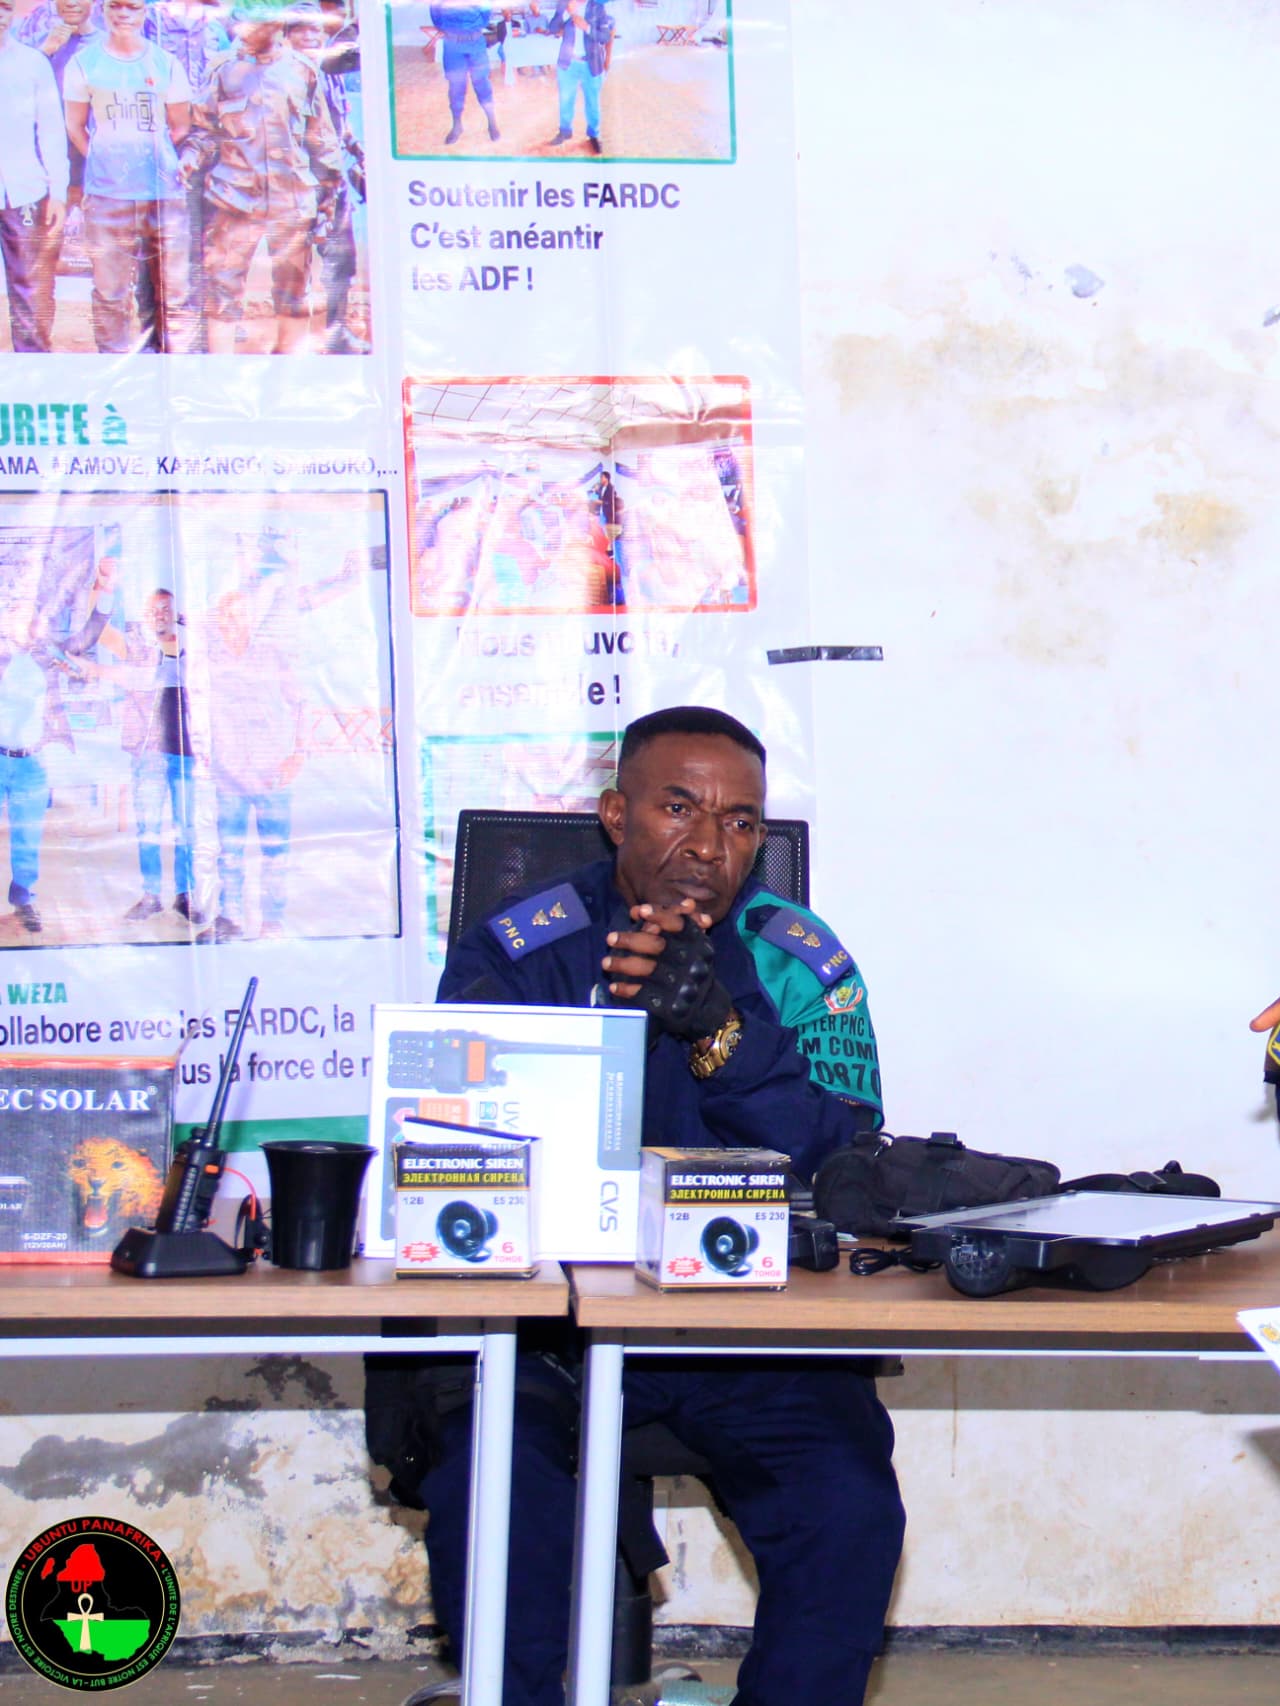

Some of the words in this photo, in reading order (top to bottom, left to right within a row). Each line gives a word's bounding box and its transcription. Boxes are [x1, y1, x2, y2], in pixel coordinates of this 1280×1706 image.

[408, 180, 529, 208] Soutenir
[535, 181, 576, 208] les
[583, 183, 681, 209] FARDC
[410, 222, 482, 249] C'est
[489, 222, 604, 250] anéantir
[412, 266, 451, 291] les
[459, 266, 519, 291] ADF
[101, 403, 129, 446] à
[498, 917, 525, 949] PNC
[821, 950, 848, 975] PNC
[7, 982, 68, 1005] WEZA
[109, 1017, 172, 1041] avec
[333, 1003, 354, 1033] la
[841, 1014, 865, 1036] PNC
[248, 1052, 315, 1082] force
[322, 1049, 354, 1079] de
[403, 1158, 483, 1169] ELECTRONIC
[485, 1158, 525, 1169] SIREN
[403, 1173, 480, 1184] ЭЛЕКТРОННАЯ
[483, 1173, 525, 1184] СИРЕНА
[671, 1174, 746, 1186] ELECTRONIC
[748, 1174, 785, 1186] SIREN
[670, 1189, 743, 1199] ЭЛЕКТРОННАЯ
[746, 1189, 785, 1199] СИРЕНА
[769, 1212, 785, 1221] 230
[502, 1241, 514, 1254] 6
[762, 1256, 774, 1268] 6
